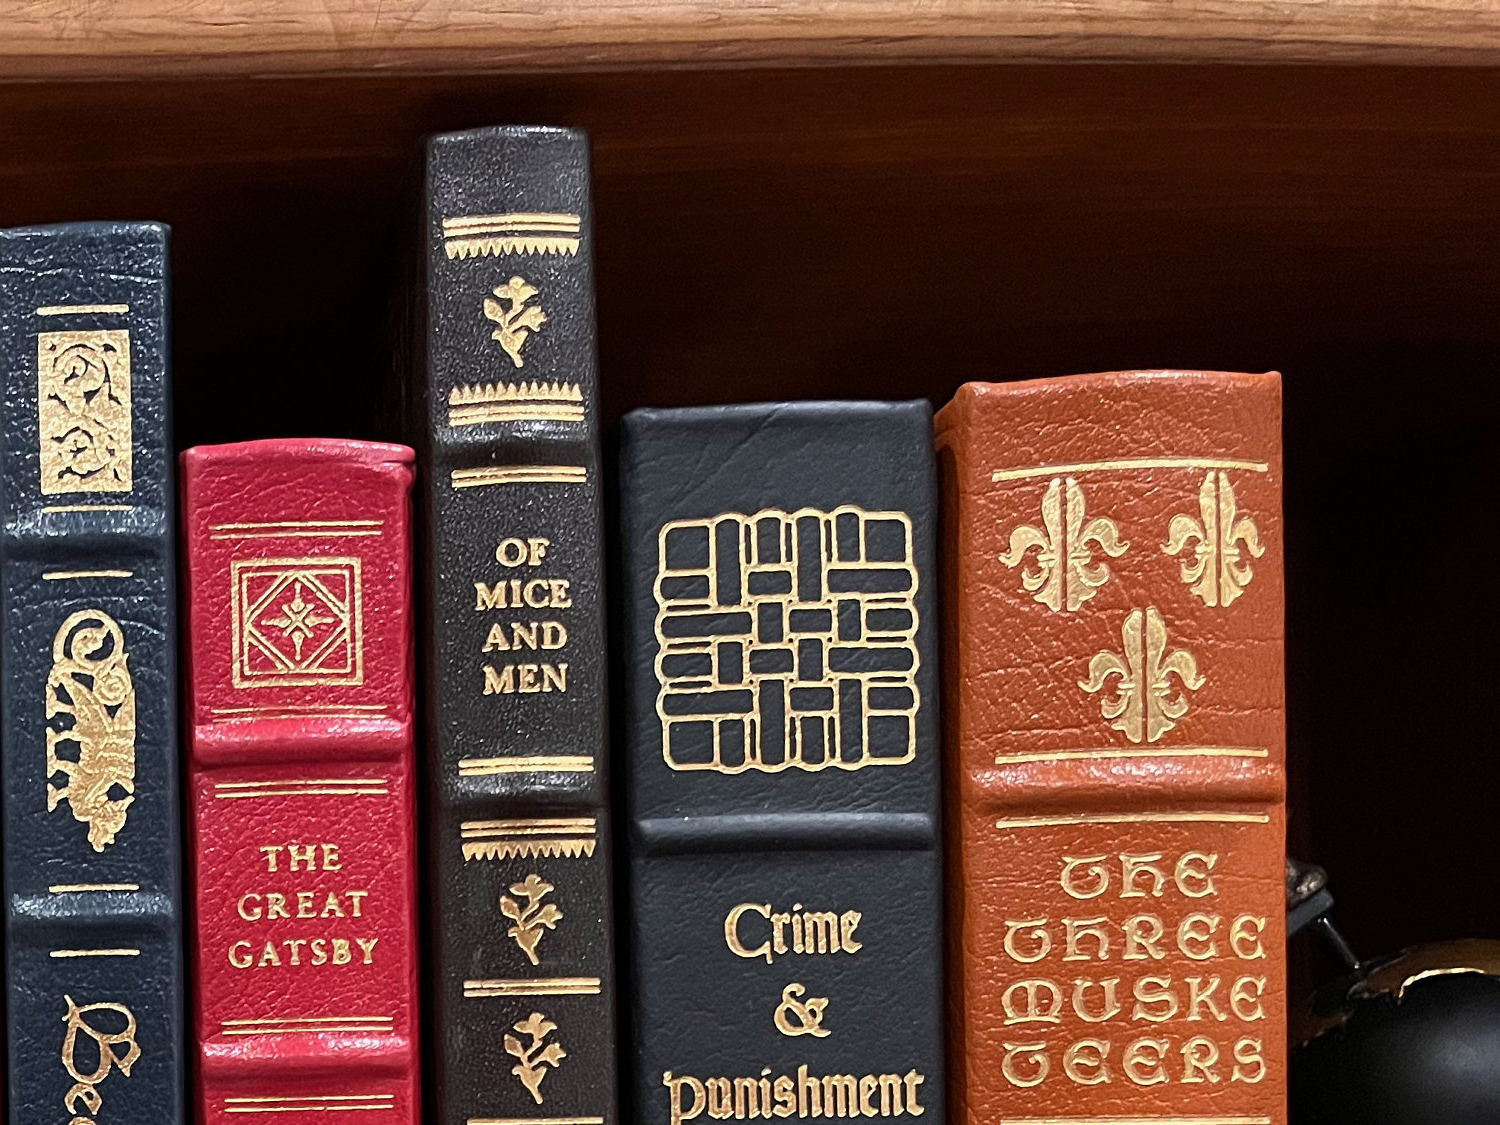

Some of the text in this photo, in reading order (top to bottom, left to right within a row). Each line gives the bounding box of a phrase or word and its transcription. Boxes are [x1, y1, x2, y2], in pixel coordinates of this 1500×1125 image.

[495, 537, 550, 568] OF
[474, 578, 572, 611] MICE
[481, 620, 568, 653] AND
[482, 662, 569, 696] MEN
[260, 843, 343, 872] THE
[1060, 851, 1219, 899] THE
[237, 890, 369, 921] GREAT
[724, 903, 863, 965] Crime
[1003, 912, 1267, 963] THREE
[228, 937, 379, 969] GATSBY
[773, 982, 832, 1038] &
[1000, 976, 1267, 1025] MUSKE
[1001, 1036, 1267, 1088] TEERS
